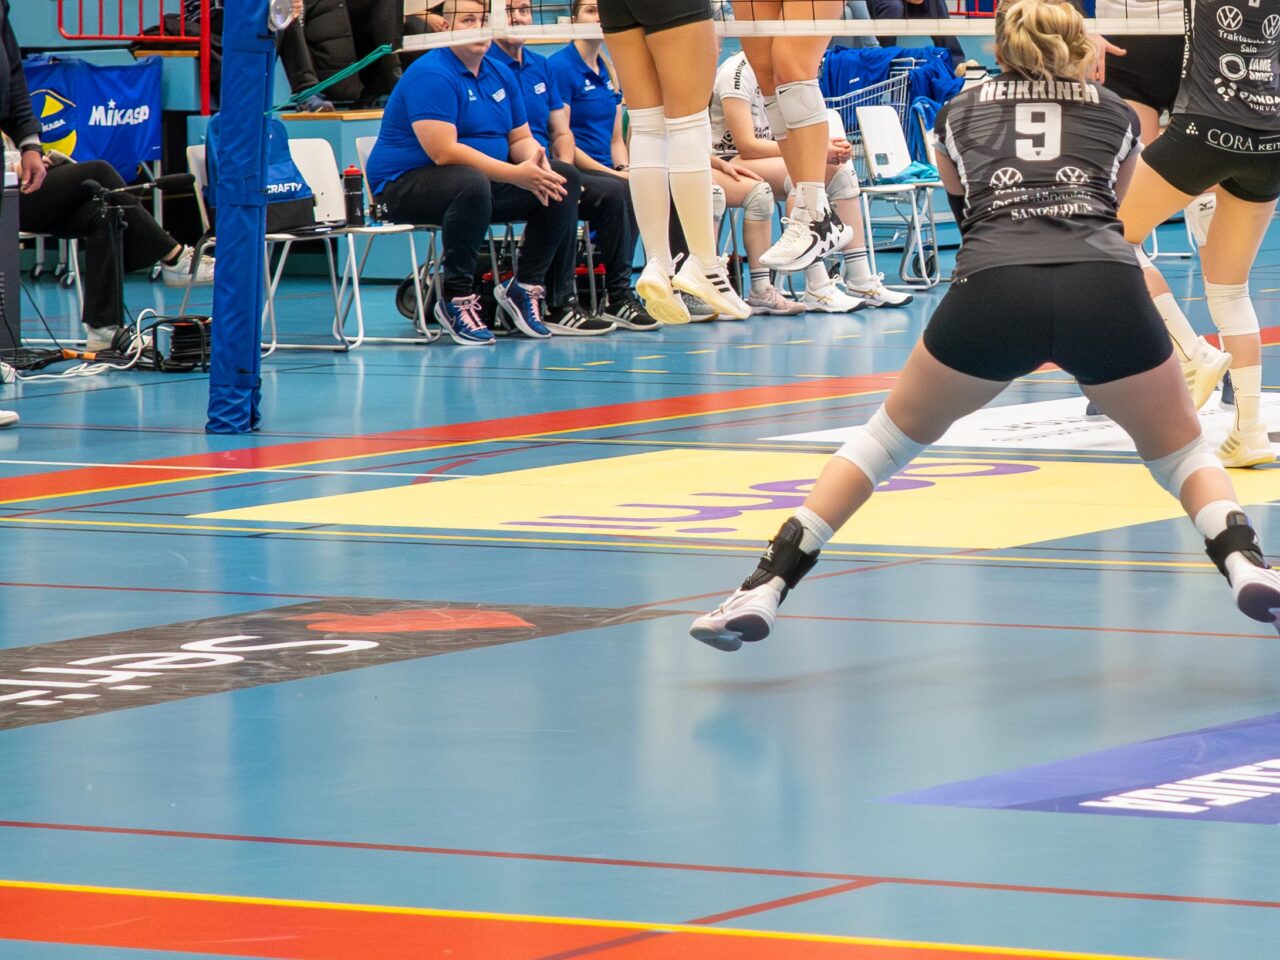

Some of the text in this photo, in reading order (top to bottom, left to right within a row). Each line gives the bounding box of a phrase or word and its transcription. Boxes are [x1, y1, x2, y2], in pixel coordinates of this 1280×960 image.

[979, 80, 1100, 104] HEIKKINEN
[1015, 102, 1062, 161] 9
[1207, 128, 1254, 151] CORA
